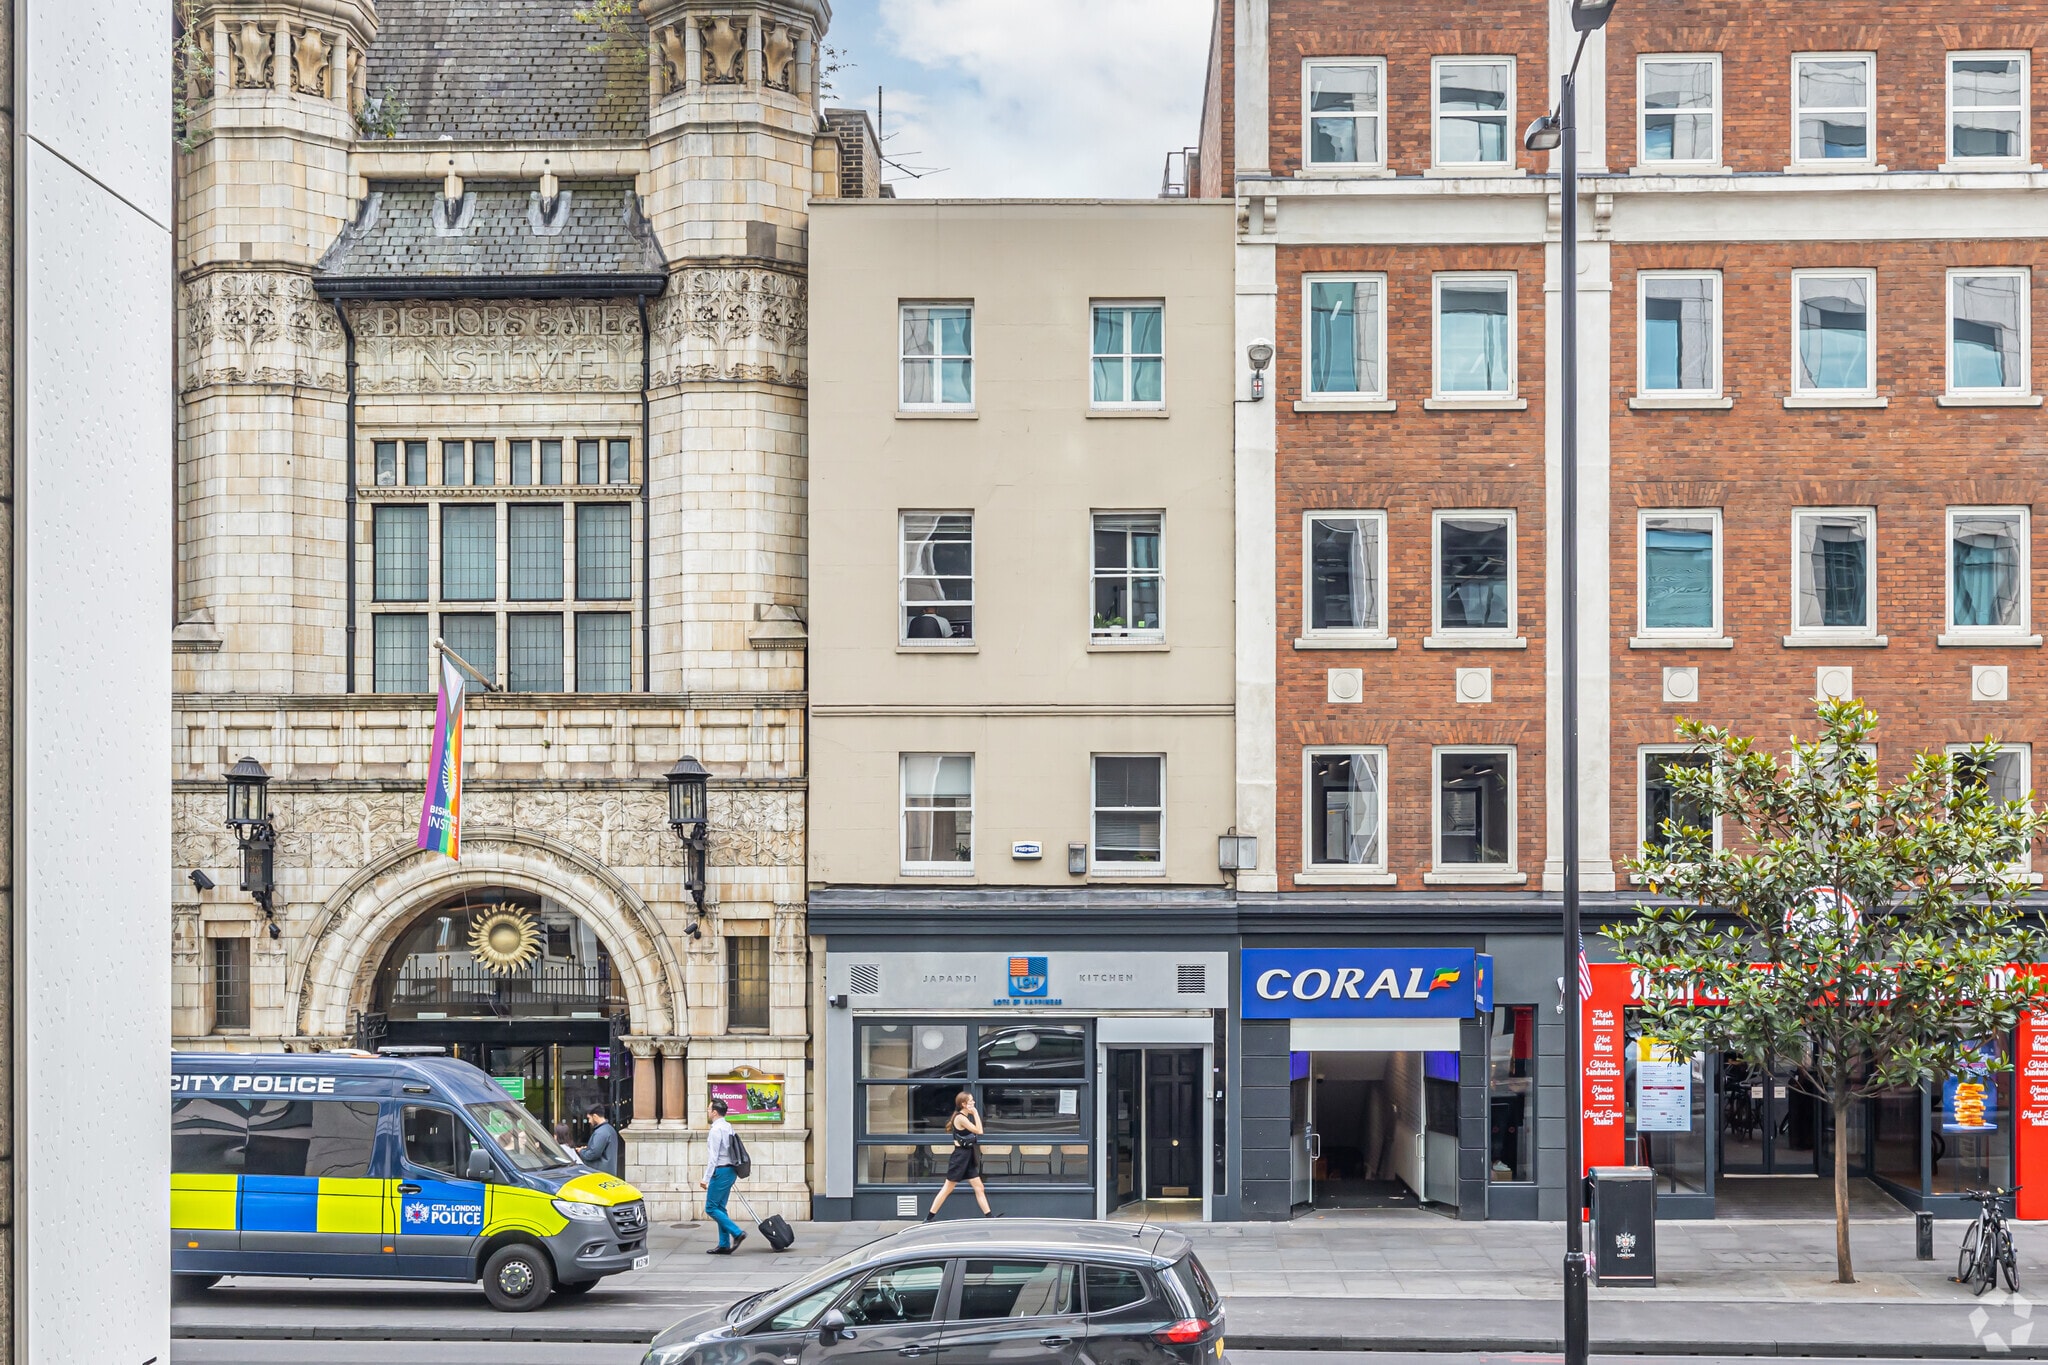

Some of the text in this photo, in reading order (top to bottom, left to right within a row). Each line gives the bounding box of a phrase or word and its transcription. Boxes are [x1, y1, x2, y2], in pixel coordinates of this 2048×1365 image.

[922, 974, 978, 983] JAPANDI
[1017, 976, 1039, 989] LOH
[1079, 974, 1134, 982] KITCHEN
[1256, 967, 1430, 1001] CORAL
[1592, 1009, 1613, 1018] Fresh
[1591, 1017, 1614, 1026] Tenders
[1595, 1034, 1611, 1043] Hot
[1594, 1042, 1613, 1052] Wings
[1590, 1059, 1616, 1069] Chicken
[1586, 1067, 1621, 1076] Sandwiches
[233, 1076, 336, 1093] POLICE
[1592, 1084, 1613, 1094] House
[712, 1092, 743, 1100] Welcome
[1595, 1093, 1615, 1101] Sauces
[1584, 1109, 1604, 1119] Hand
[1593, 1117, 1613, 1126] Shakes
[451, 1204, 481, 1212] LONDON
[431, 1211, 481, 1225] POLICE
